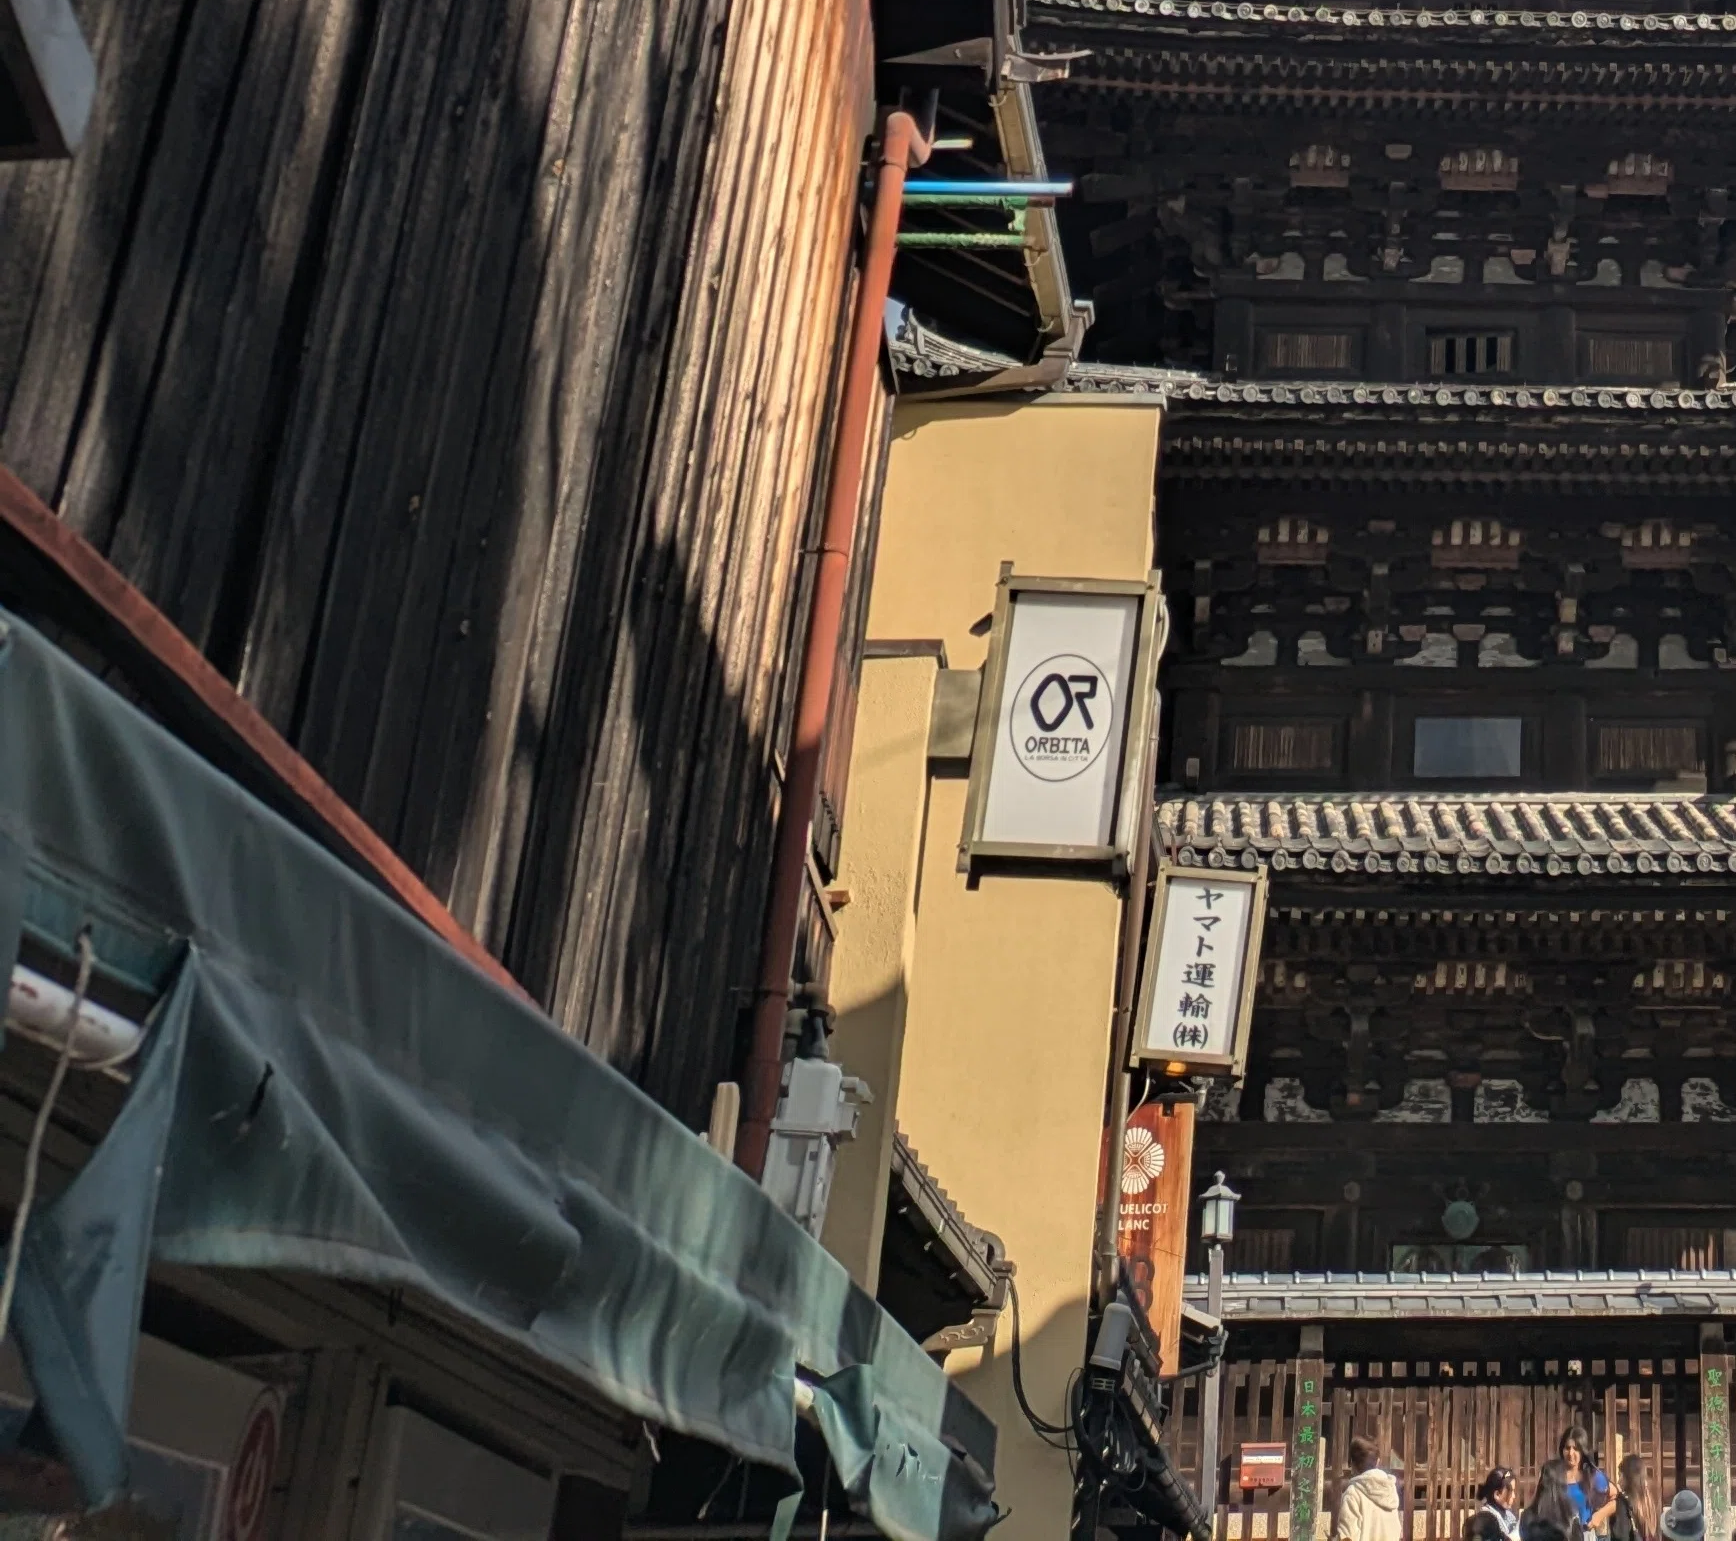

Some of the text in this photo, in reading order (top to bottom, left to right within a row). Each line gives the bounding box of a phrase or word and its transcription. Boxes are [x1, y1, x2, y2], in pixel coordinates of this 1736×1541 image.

[1025, 736, 1091, 755] ORBITA
[1119, 1203, 1169, 1215] UELICOT
[1118, 1219, 1151, 1231] LANC
